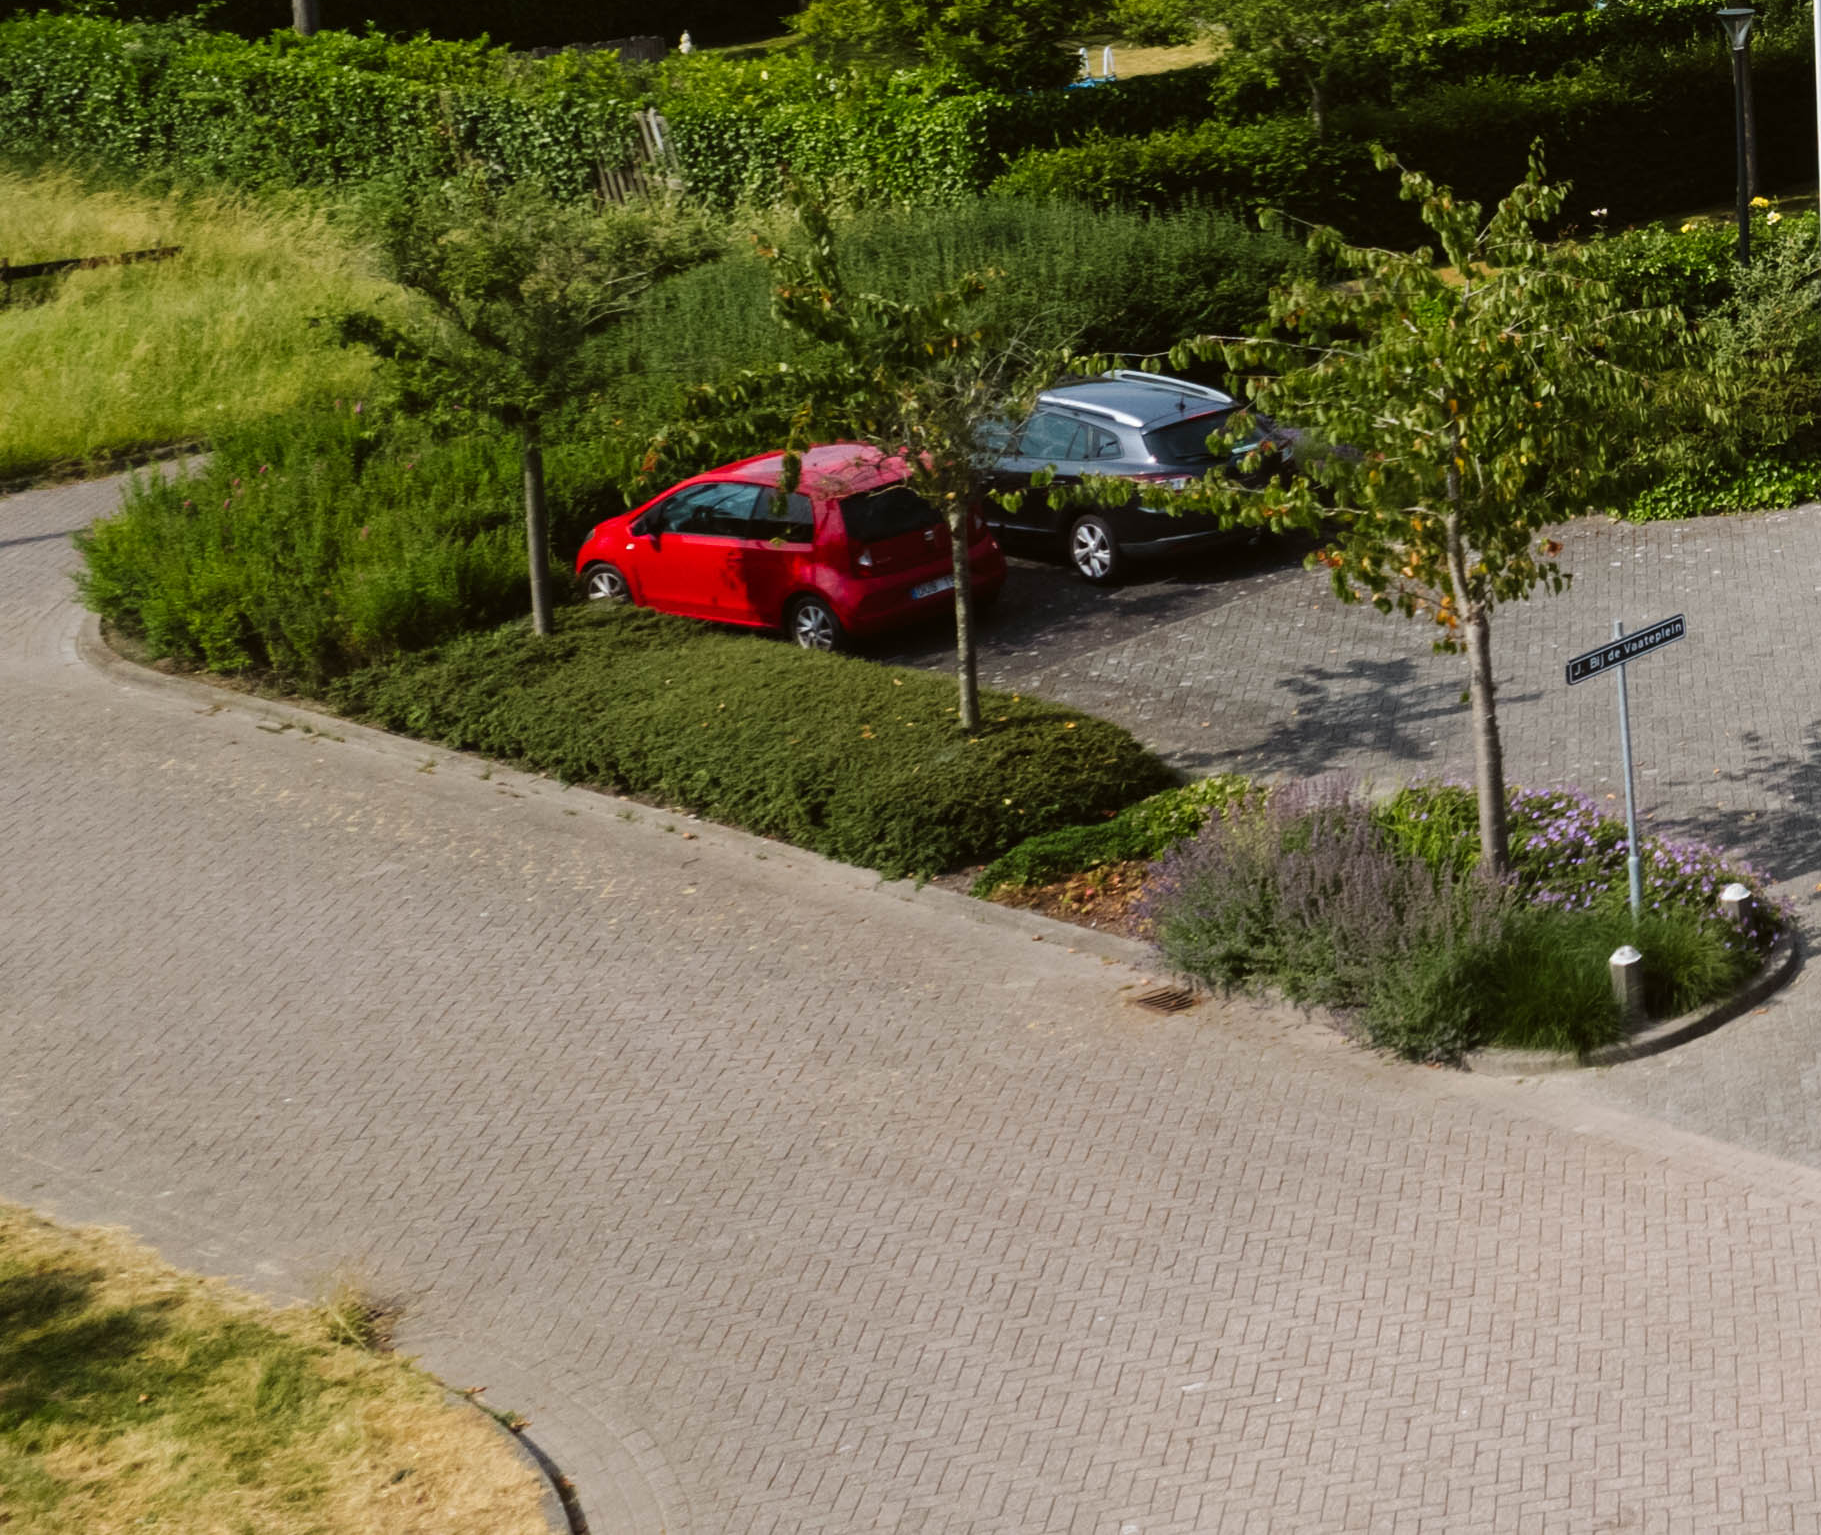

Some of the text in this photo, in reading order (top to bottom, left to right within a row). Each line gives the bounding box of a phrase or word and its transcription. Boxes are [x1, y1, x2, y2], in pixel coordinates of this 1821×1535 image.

[1590, 655, 1604, 670] Bij
[1608, 649, 1621, 661] de
[1624, 623, 1682, 654] Vaateplein
